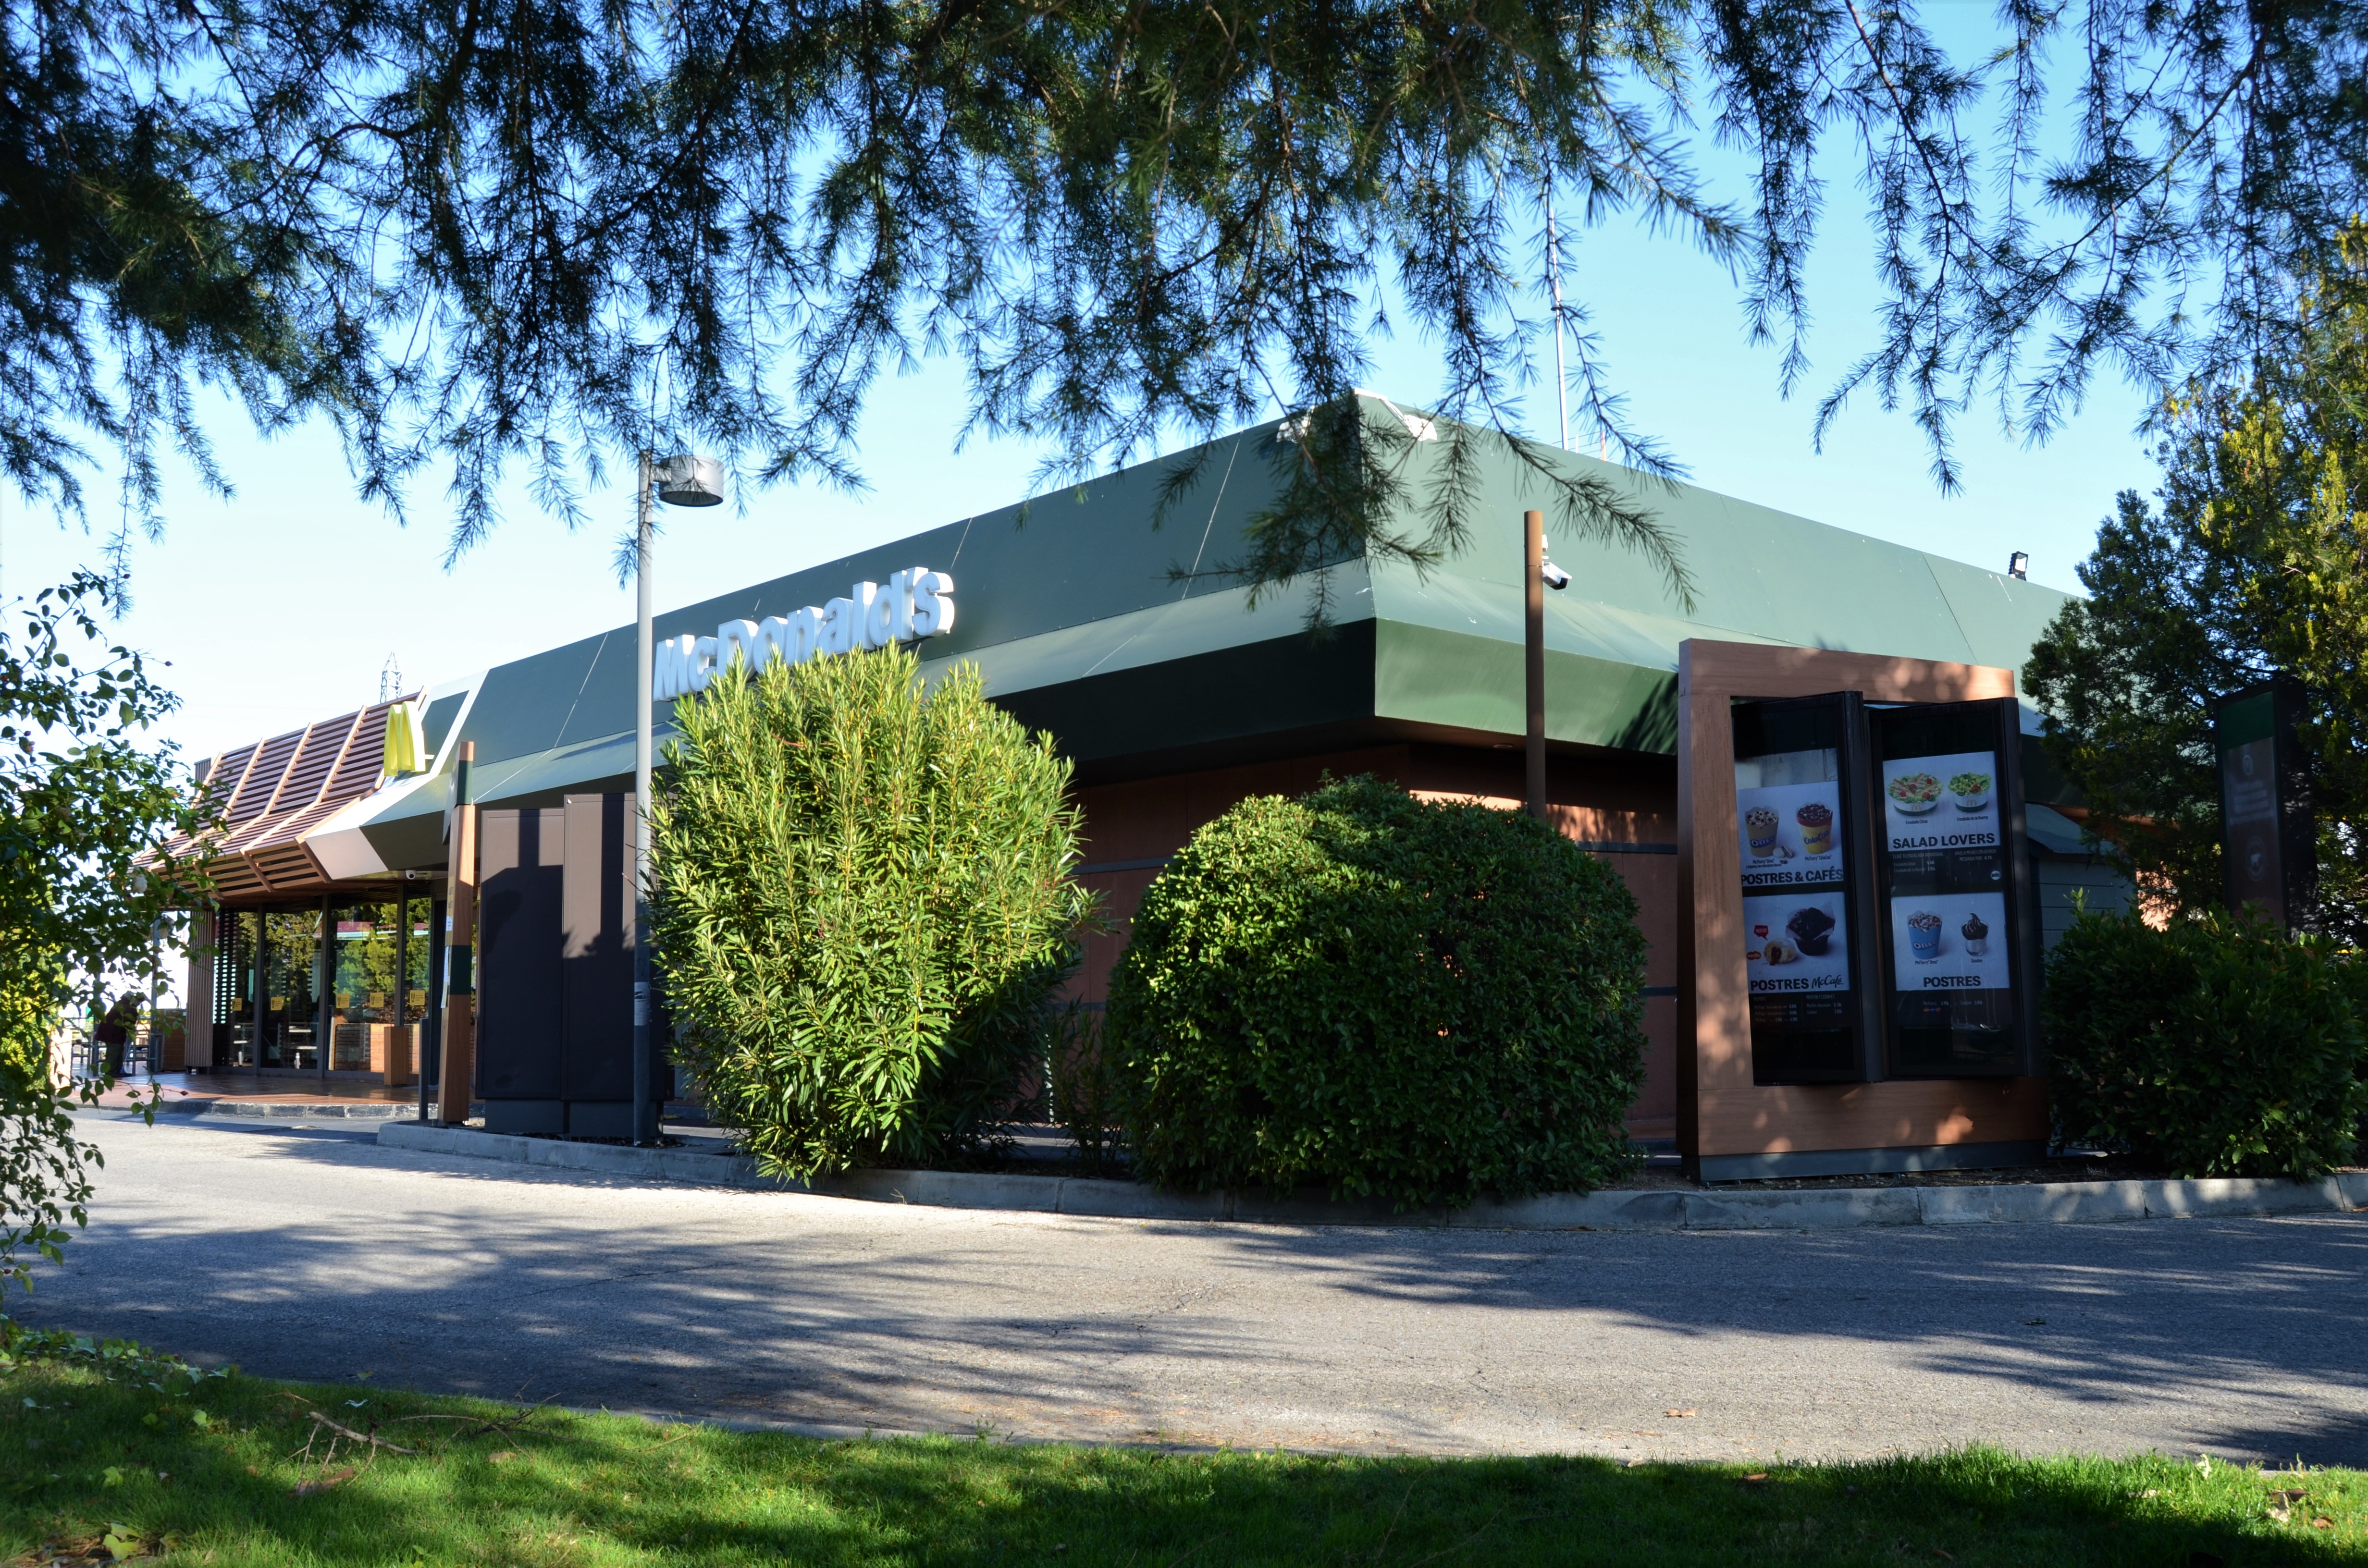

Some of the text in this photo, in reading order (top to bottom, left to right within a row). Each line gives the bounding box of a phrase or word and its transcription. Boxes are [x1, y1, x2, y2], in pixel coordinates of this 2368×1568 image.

[653, 566, 955, 702] McDonald's
[1751, 836, 1776, 847] OREO
[1804, 830, 1829, 845] ColaCao
[1893, 833, 1995, 849] SALAD LOVERS
[1741, 866, 1843, 885] POSTRES & CAFÉS
[1913, 940, 1937, 949] OREO
[1751, 978, 1809, 991] POSTRES
[1924, 976, 1981, 987] POSTRES
